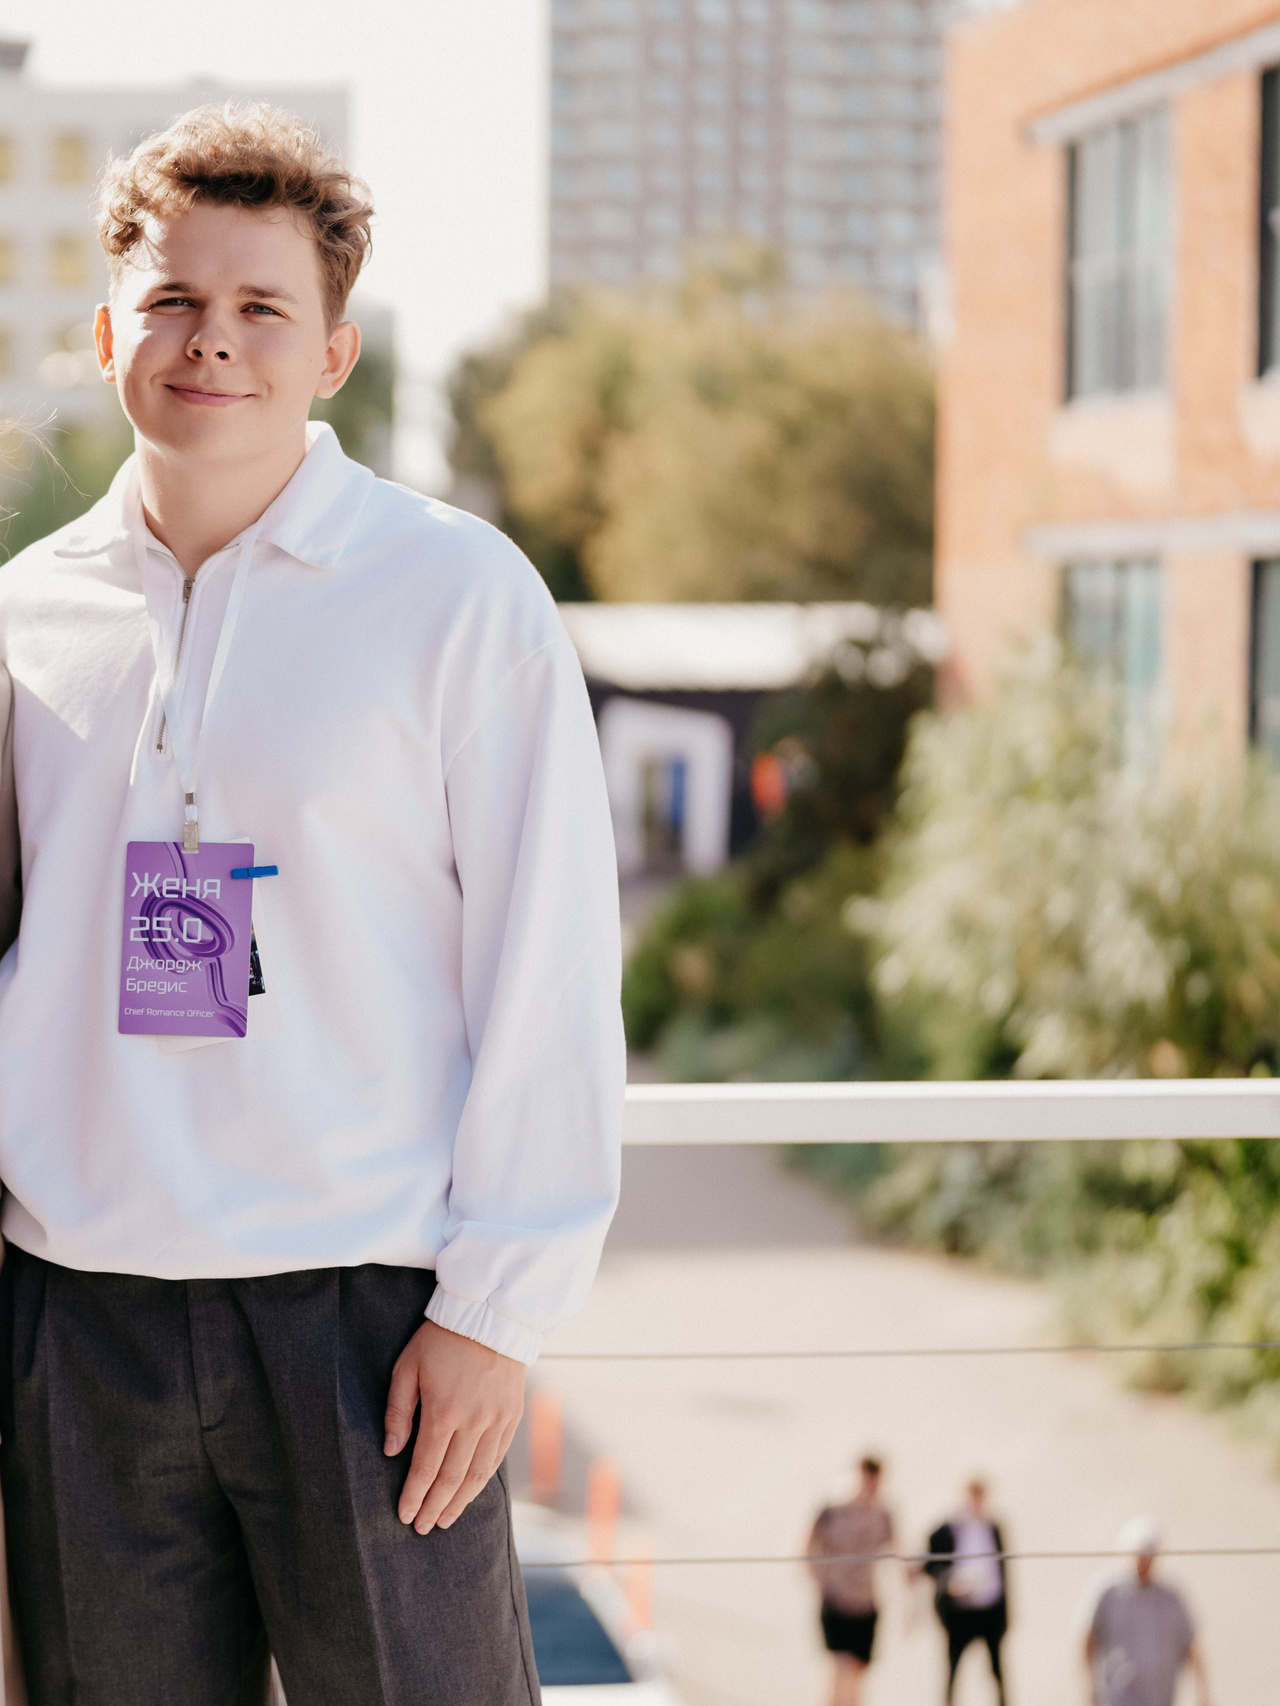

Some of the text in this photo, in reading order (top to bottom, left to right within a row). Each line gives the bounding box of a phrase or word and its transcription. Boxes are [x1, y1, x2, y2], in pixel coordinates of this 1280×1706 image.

[131, 872, 221, 899] Женя
[130, 916, 202, 943] 25.0
[126, 956, 202, 972] Джордж
[126, 978, 188, 994] Бредис
[124, 1007, 215, 1017] Chief Romance Officer
